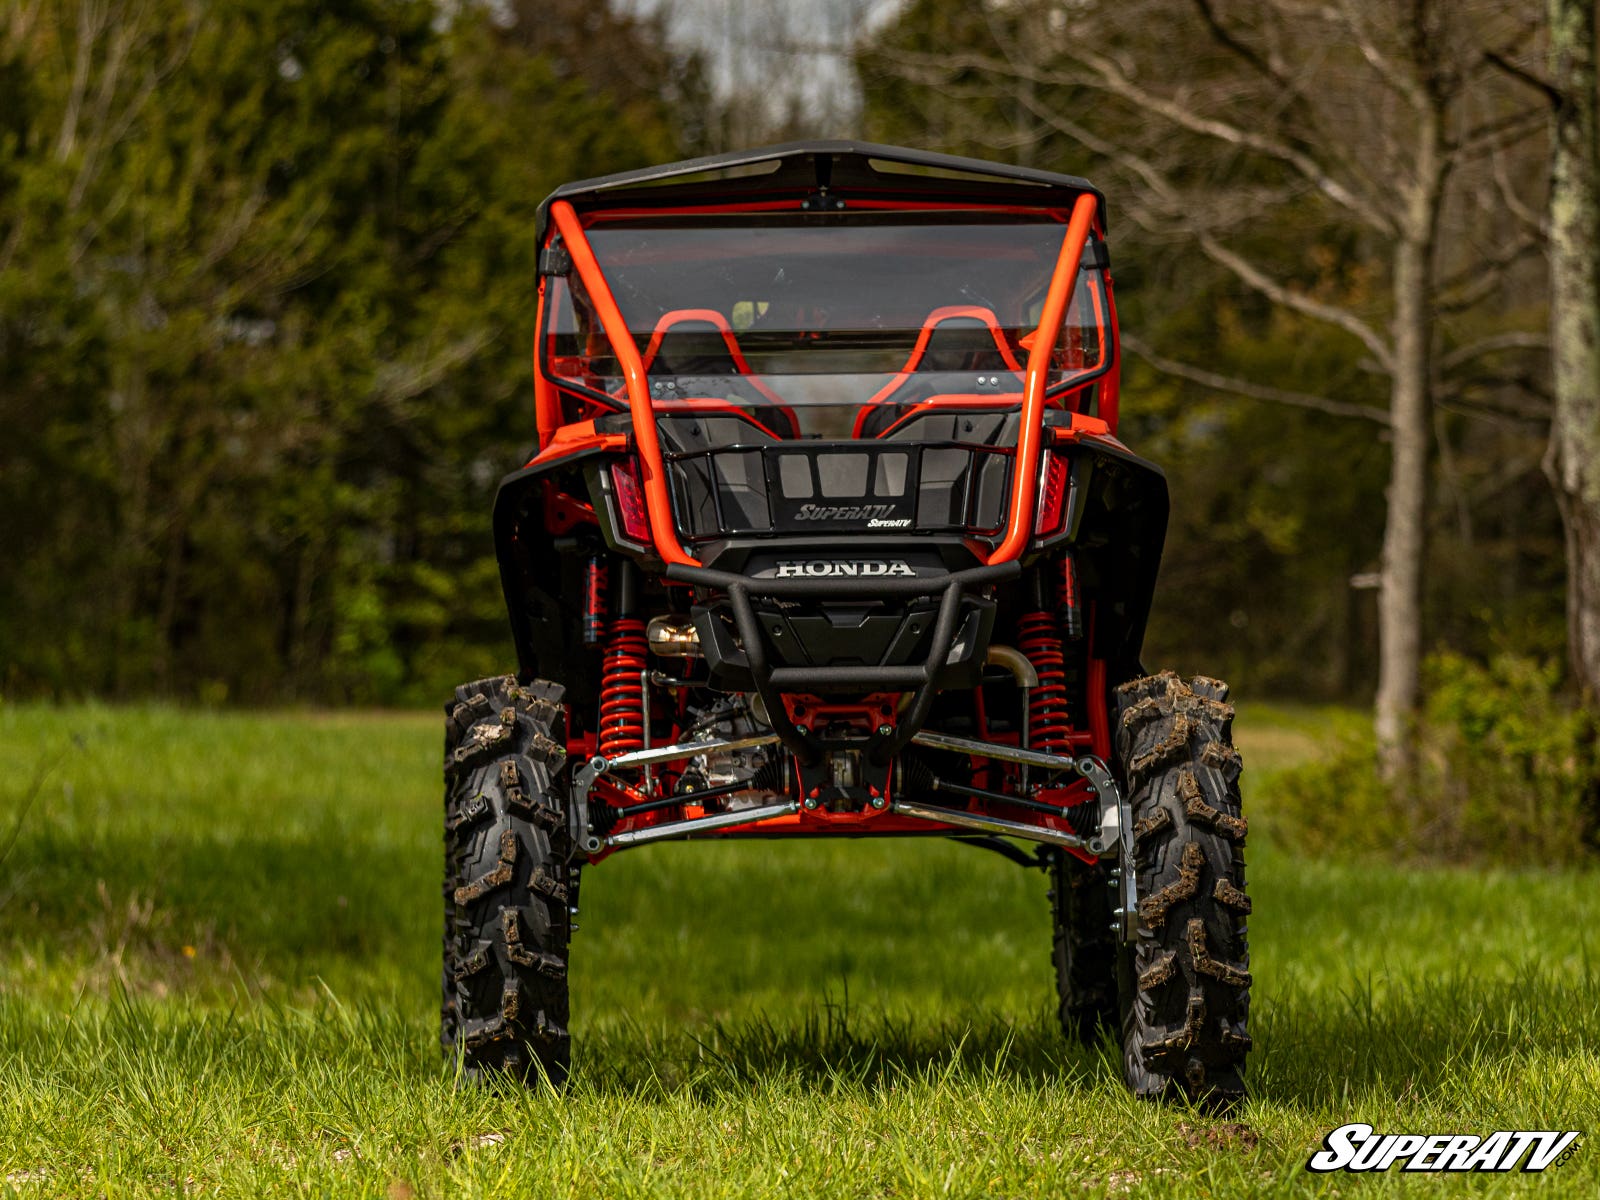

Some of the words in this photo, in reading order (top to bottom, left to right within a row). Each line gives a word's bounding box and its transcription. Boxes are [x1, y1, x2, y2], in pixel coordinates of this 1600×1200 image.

[794, 504, 896, 520] SUPERATV
[867, 519, 911, 528] SUPERATV
[776, 560, 916, 577] HONDA
